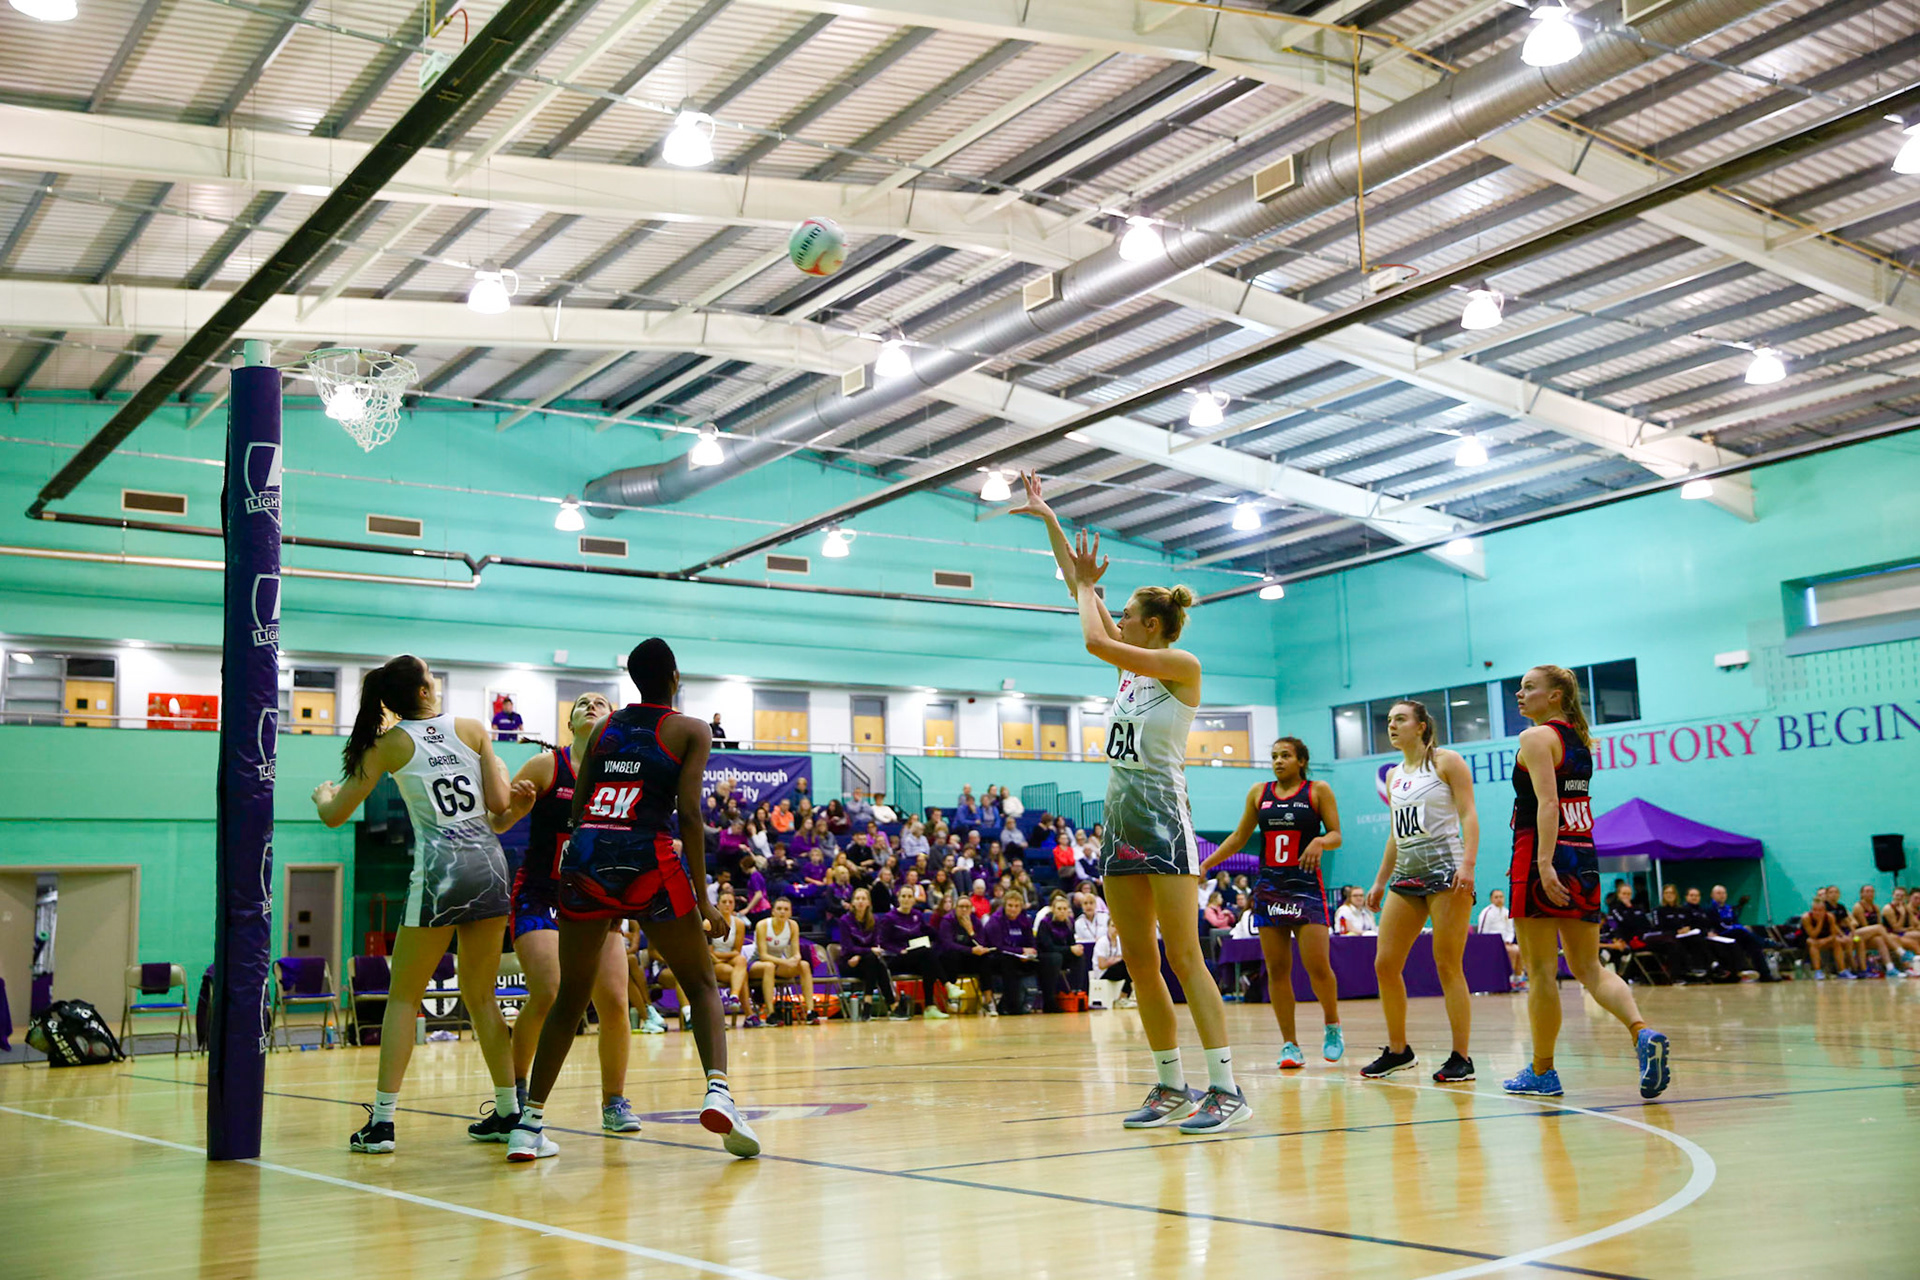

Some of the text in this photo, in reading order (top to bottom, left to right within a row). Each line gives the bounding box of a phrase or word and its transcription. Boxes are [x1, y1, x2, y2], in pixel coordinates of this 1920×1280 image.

[1107, 722, 1139, 763] GA
[428, 754, 460, 767] GABRIEL
[604, 760, 641, 774] VIMBELA
[1463, 750, 1516, 784] HE
[702, 767, 788, 787] oughborough
[432, 775, 475, 817] GS
[1395, 806, 1426, 839] WA
[1275, 834, 1289, 863] C
[1267, 902, 1302, 918] Vitality
